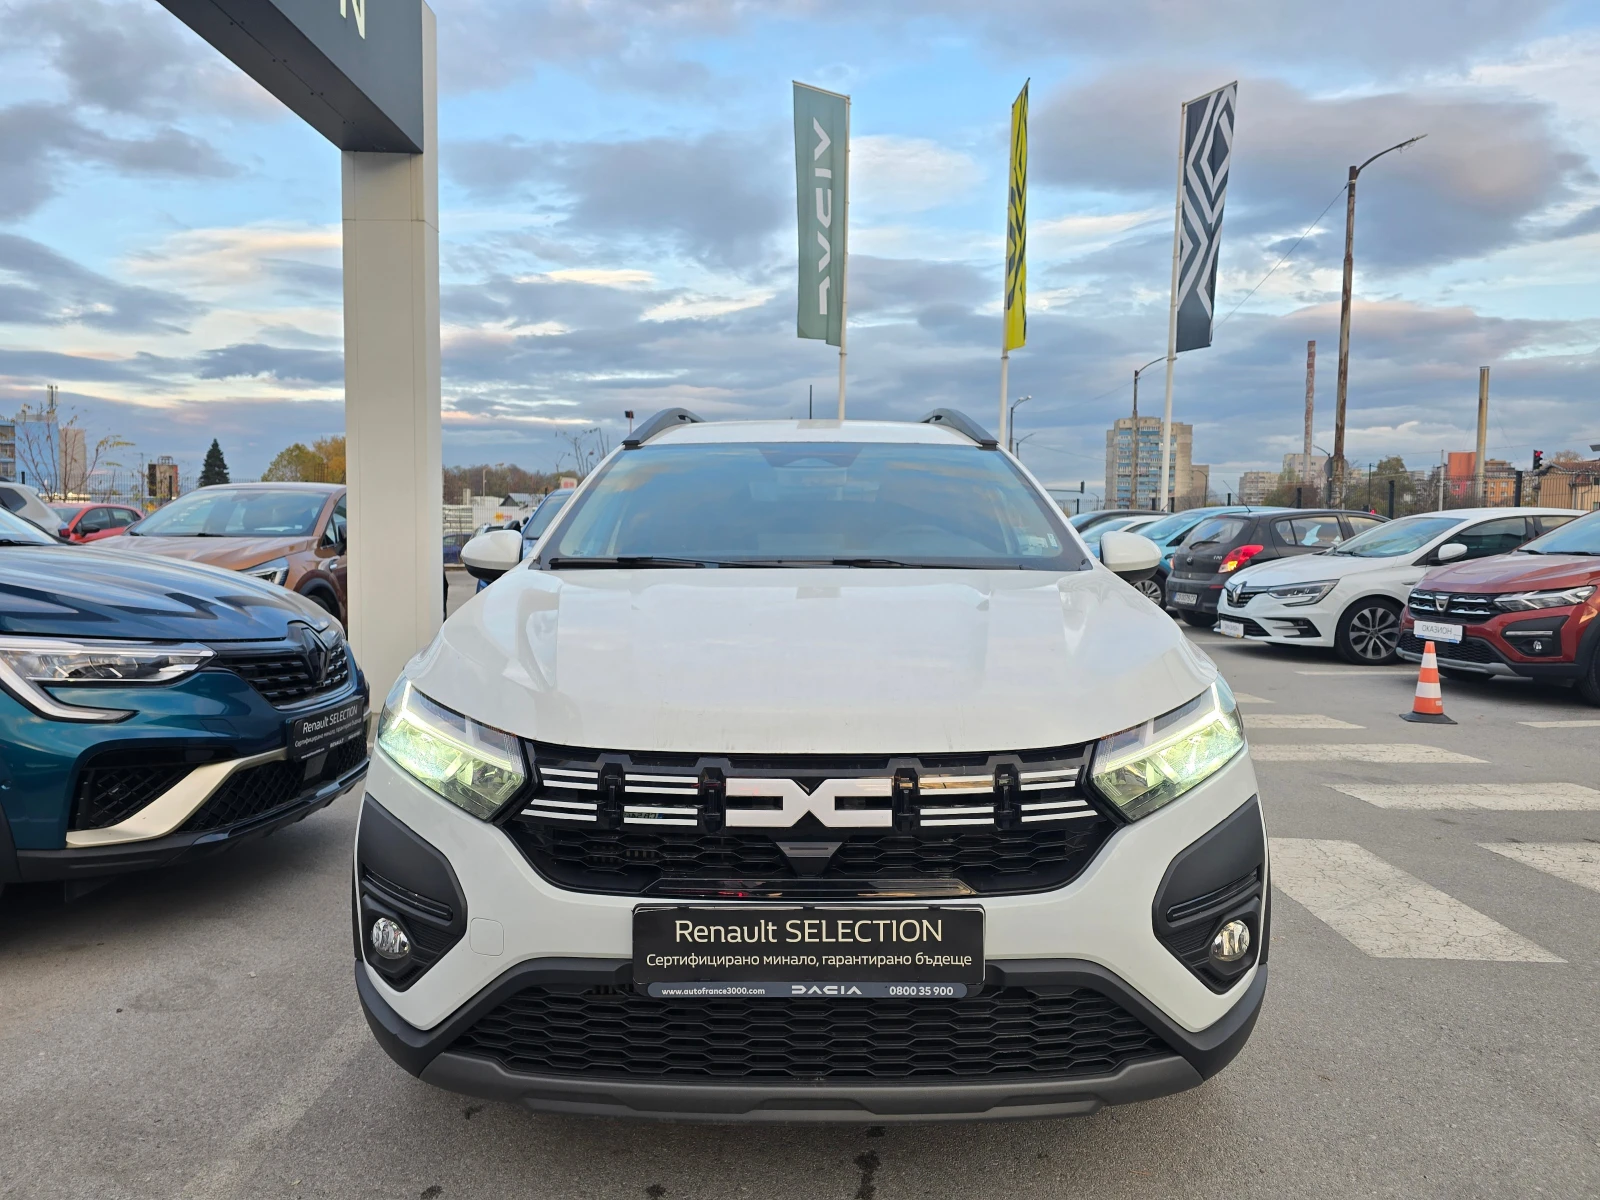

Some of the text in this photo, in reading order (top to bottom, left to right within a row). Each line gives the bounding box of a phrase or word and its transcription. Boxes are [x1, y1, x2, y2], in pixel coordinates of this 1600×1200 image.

[812, 116, 833, 316] DACIA
[303, 716, 329, 734] Renault
[329, 705, 358, 725] SELECTION
[674, 919, 943, 943] Renault SELECTION
[646, 952, 972, 968] Сертифицирано минало, гарантирано бъдеще
[661, 987, 766, 995] www.autofrance3000.com
[791, 985, 862, 995] DACIA
[889, 986, 954, 996] 0800 35 900
